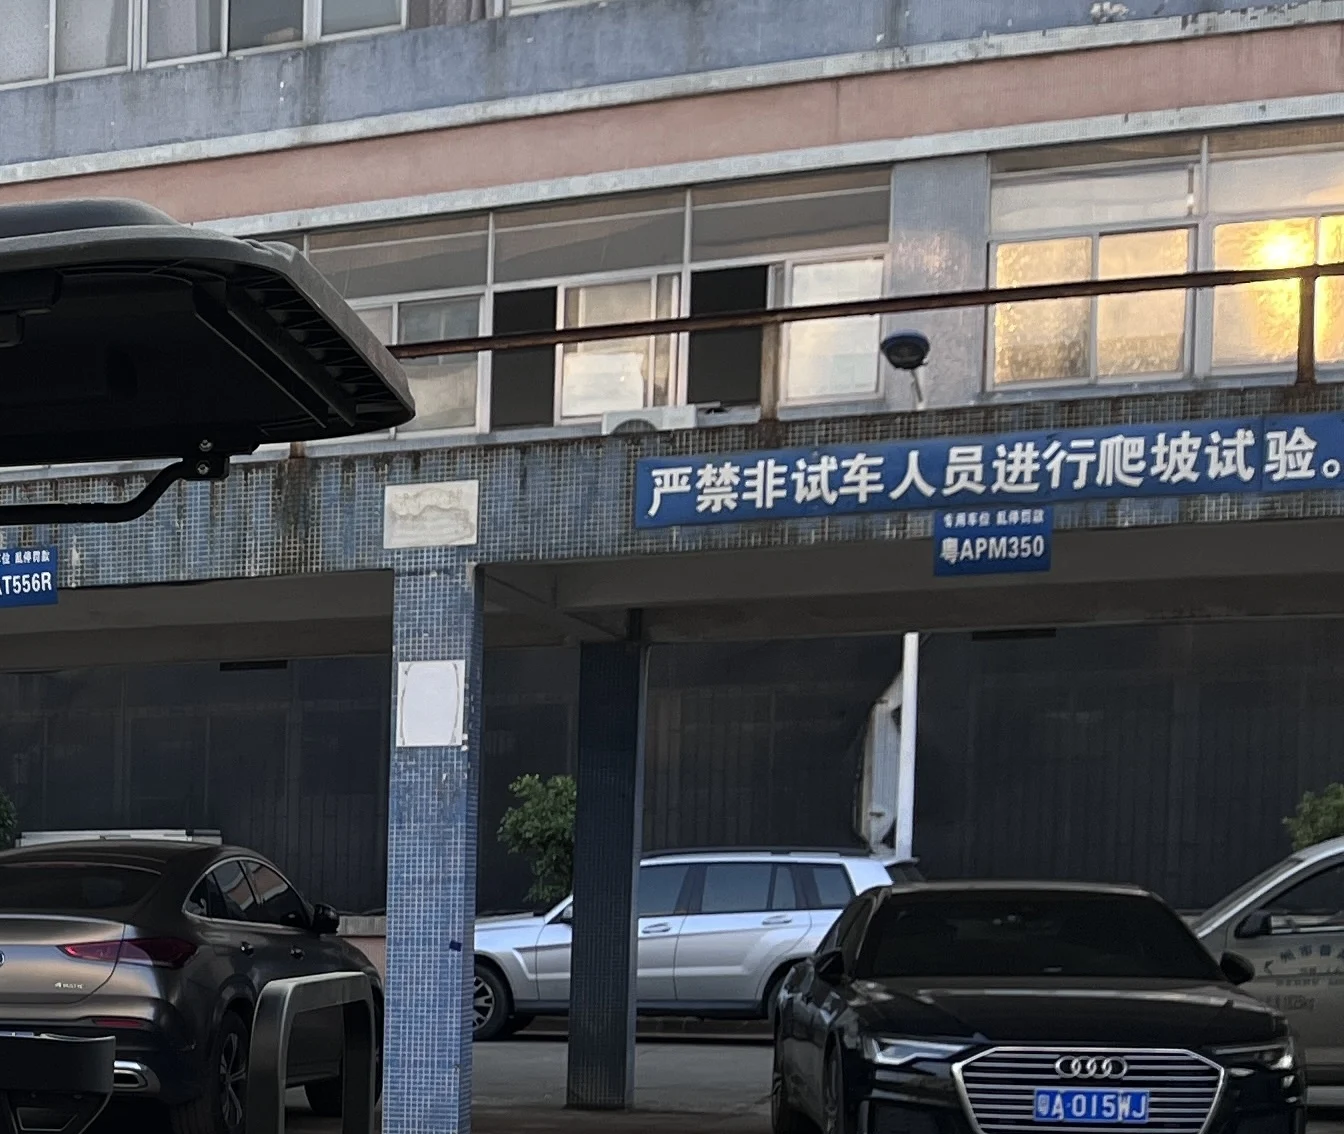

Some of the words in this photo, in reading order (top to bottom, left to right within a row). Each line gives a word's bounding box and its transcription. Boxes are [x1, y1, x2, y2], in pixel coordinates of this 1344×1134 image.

[647, 426, 1341, 518] 严禁非试车人员进行爬坡试验。
[940, 534, 1045, 565] 粤APM350
